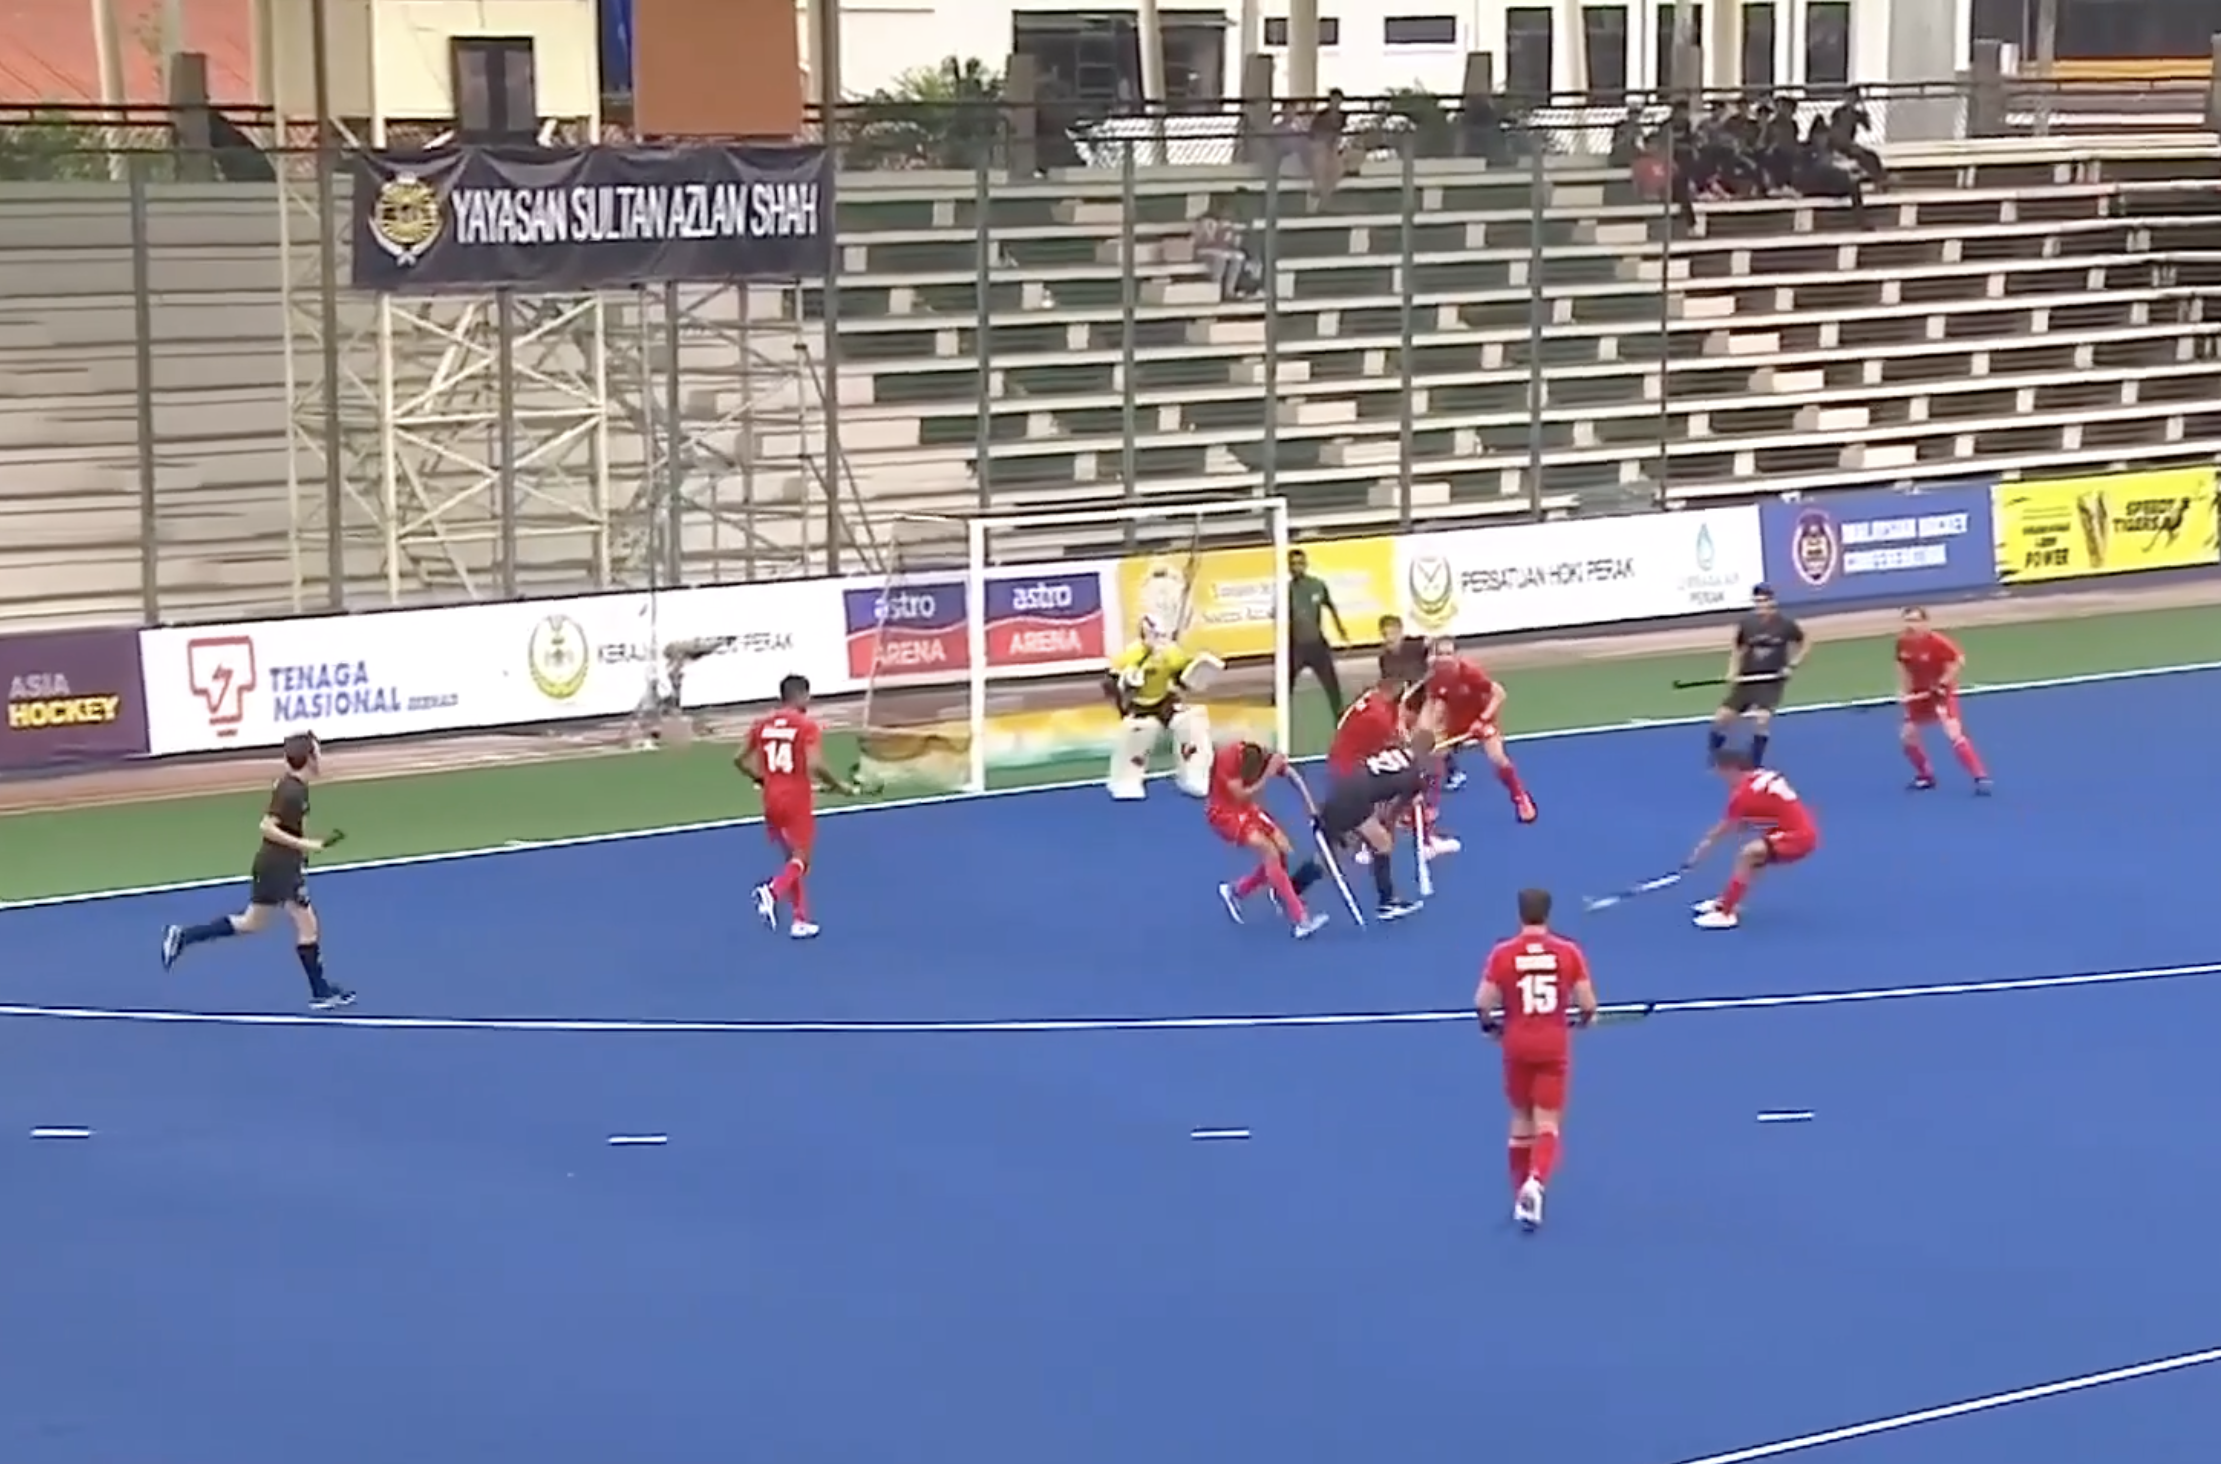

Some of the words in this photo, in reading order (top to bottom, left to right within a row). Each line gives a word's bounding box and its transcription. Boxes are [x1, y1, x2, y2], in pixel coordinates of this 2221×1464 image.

[452, 187, 566, 244] YAYASAN
[571, 185, 667, 242] SULTAN
[668, 184, 747, 240] AZLAN
[751, 182, 817, 237] SHAH
[2025, 548, 2070, 569] POWER
[1461, 567, 1545, 593] PERSATUAN
[1587, 558, 1635, 582] PERAK
[874, 592, 935, 619] astro
[1013, 582, 1072, 610] astro
[874, 638, 947, 665] ARENA
[1010, 630, 1082, 655] ARENA
[8, 672, 71, 699] ASIA
[269, 661, 368, 692] TENAGA
[8, 695, 120, 727] HOCKEY
[274, 687, 400, 722] NASIONAL
[763, 740, 794, 774] 14
[1516, 974, 1557, 1014] 15
